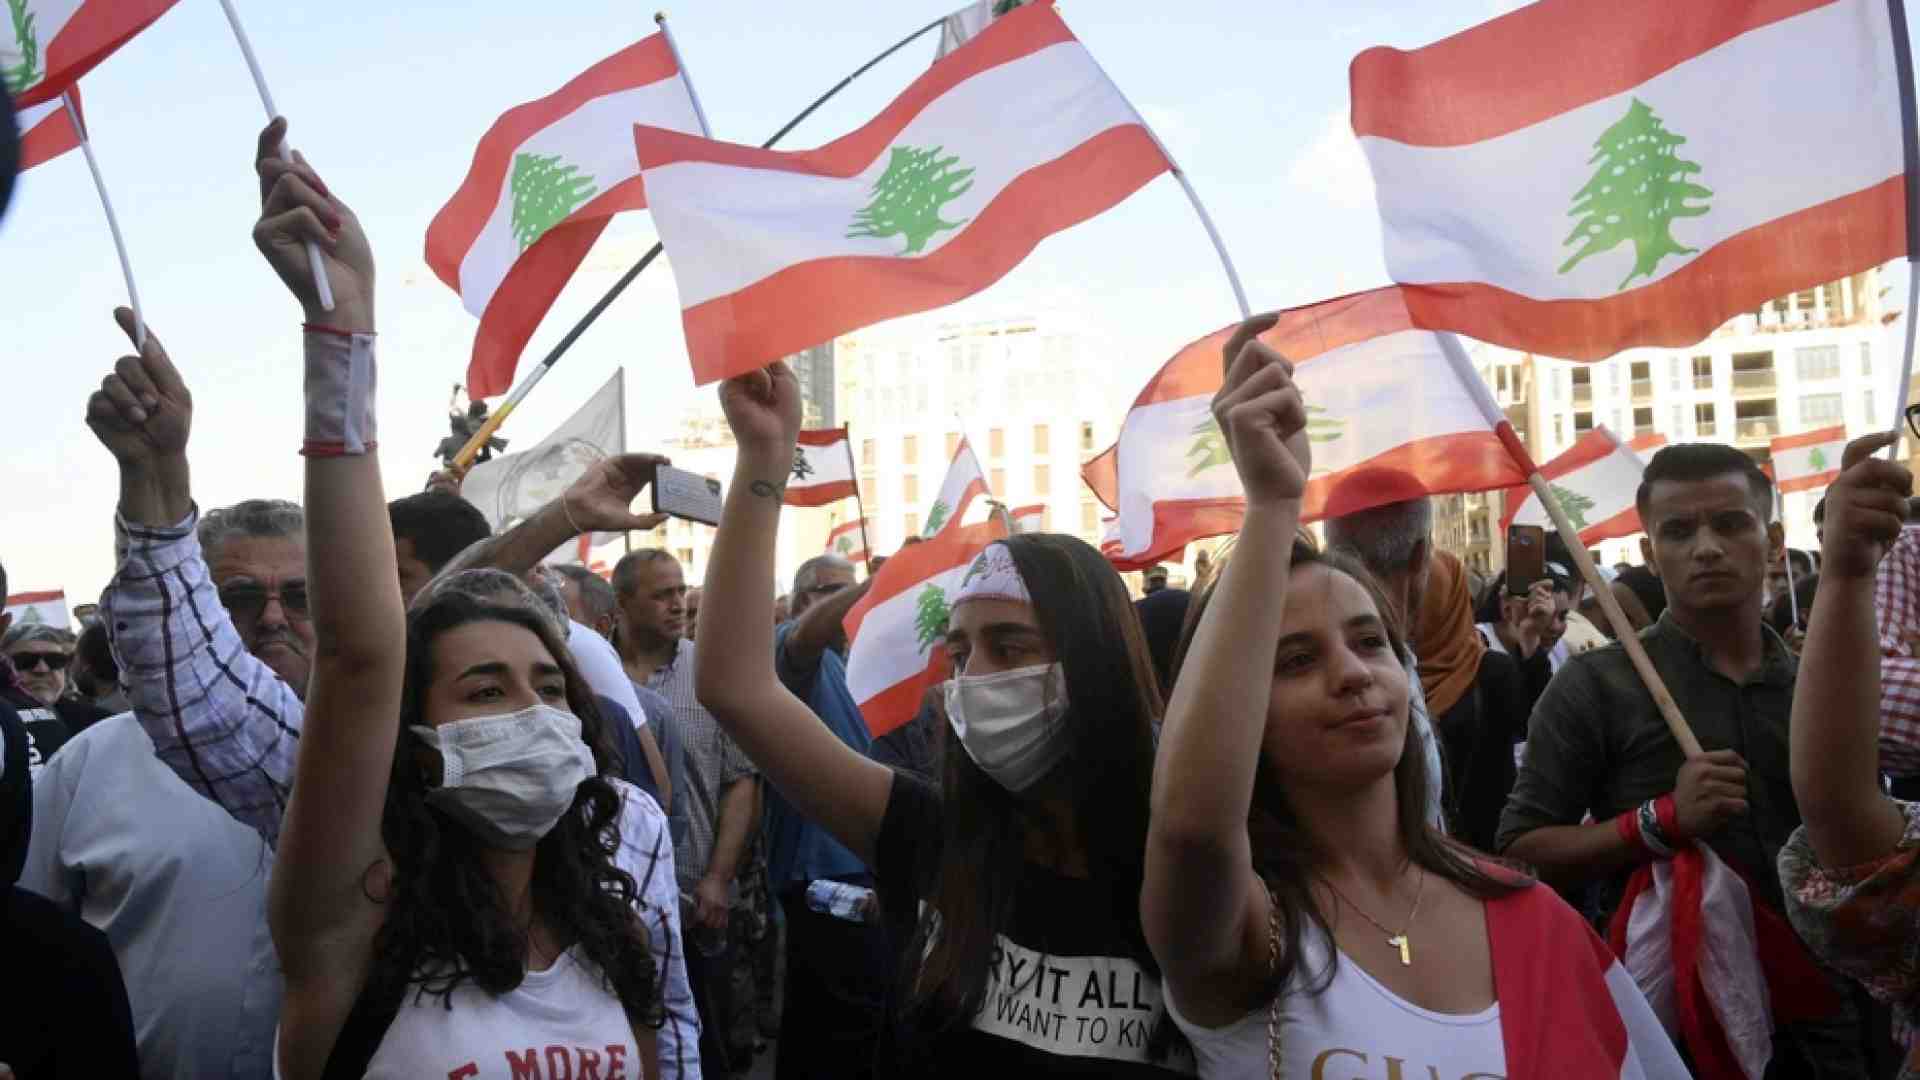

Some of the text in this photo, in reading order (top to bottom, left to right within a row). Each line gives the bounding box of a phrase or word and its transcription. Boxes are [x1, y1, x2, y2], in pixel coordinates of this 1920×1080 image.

[986, 945, 1026, 987] RY
[1035, 964, 1070, 1004] IT
[1078, 969, 1151, 1011] ALL
[997, 994, 1067, 1042] WANT
[1076, 1016, 1109, 1044] TO
[1118, 1018, 1153, 1048] KN
[504, 1044, 627, 1080] MORE
